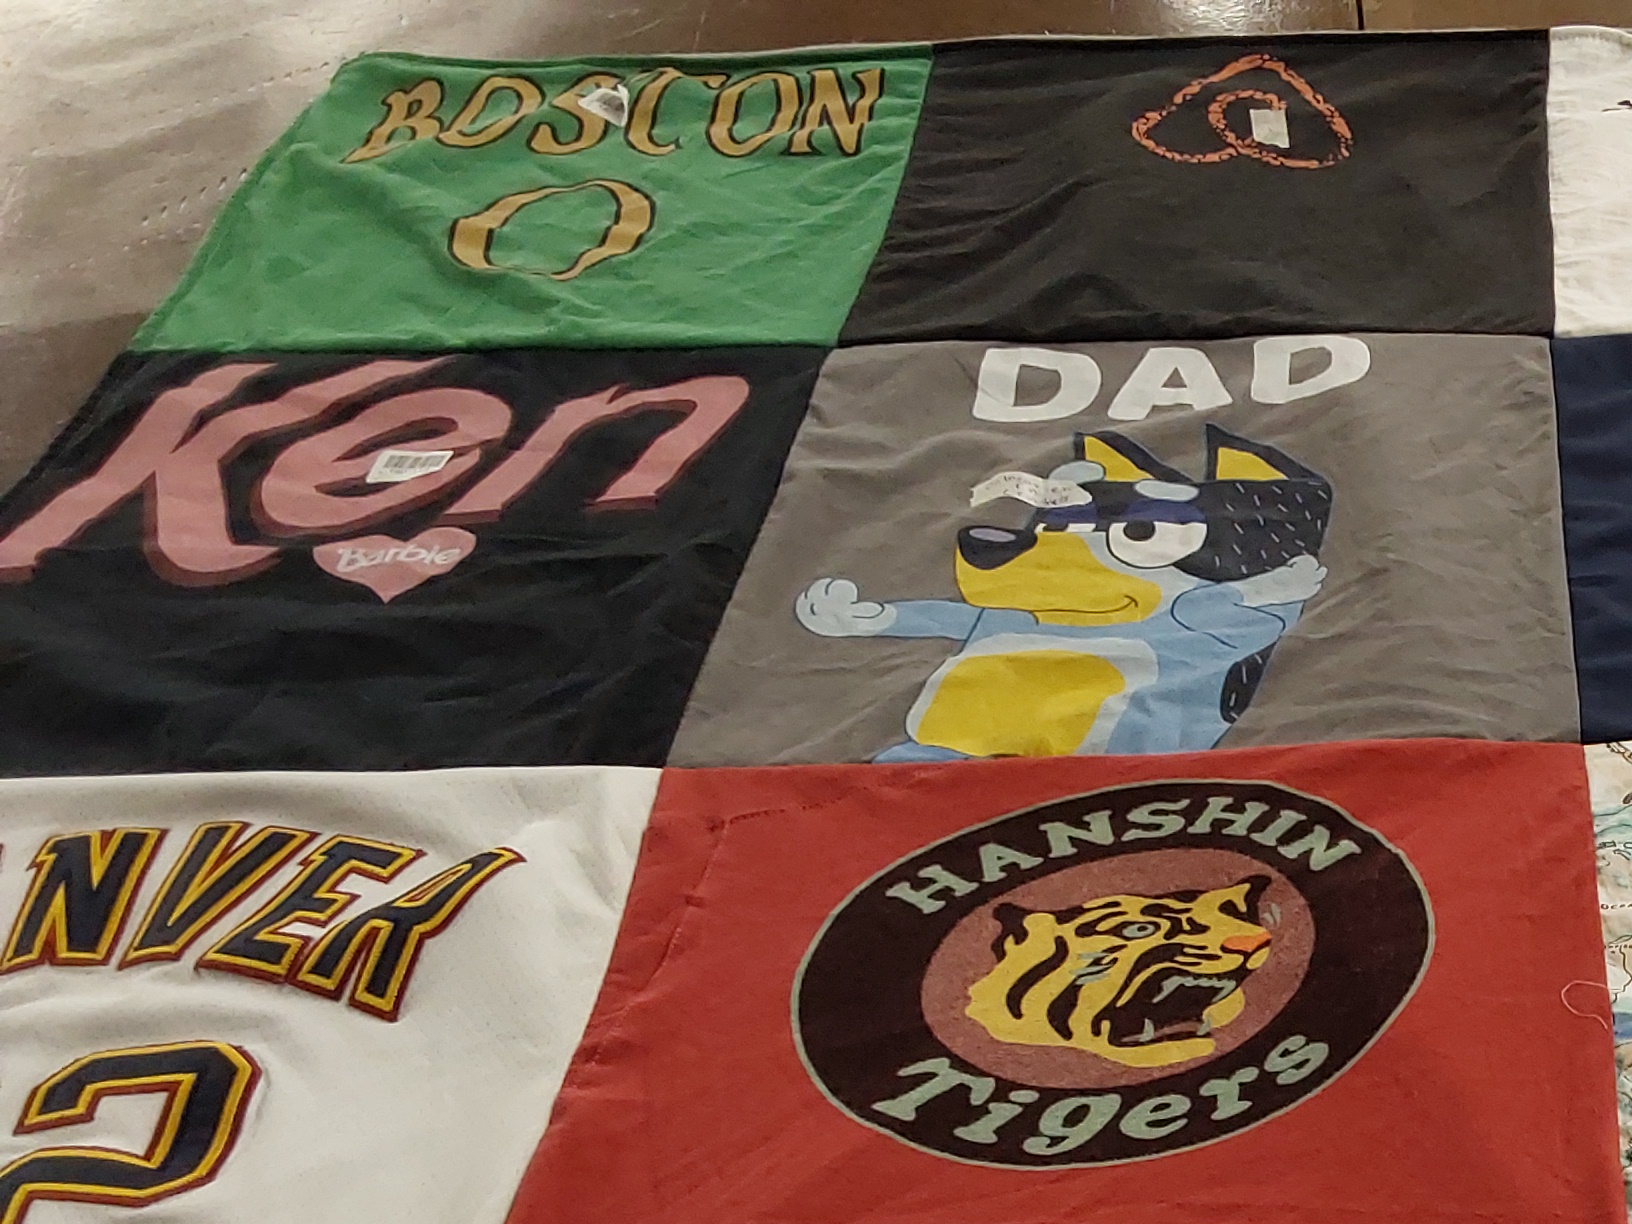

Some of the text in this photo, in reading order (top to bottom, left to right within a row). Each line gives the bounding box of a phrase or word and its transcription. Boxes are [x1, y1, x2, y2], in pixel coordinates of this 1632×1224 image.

[972, 334, 1370, 423] DAD
[0, 358, 750, 586] Ken
[336, 544, 461, 573] Barbie
[886, 795, 1363, 914] HANSHIN
[0, 821, 527, 1022] NVER
[872, 1033, 1330, 1156] Tigers
